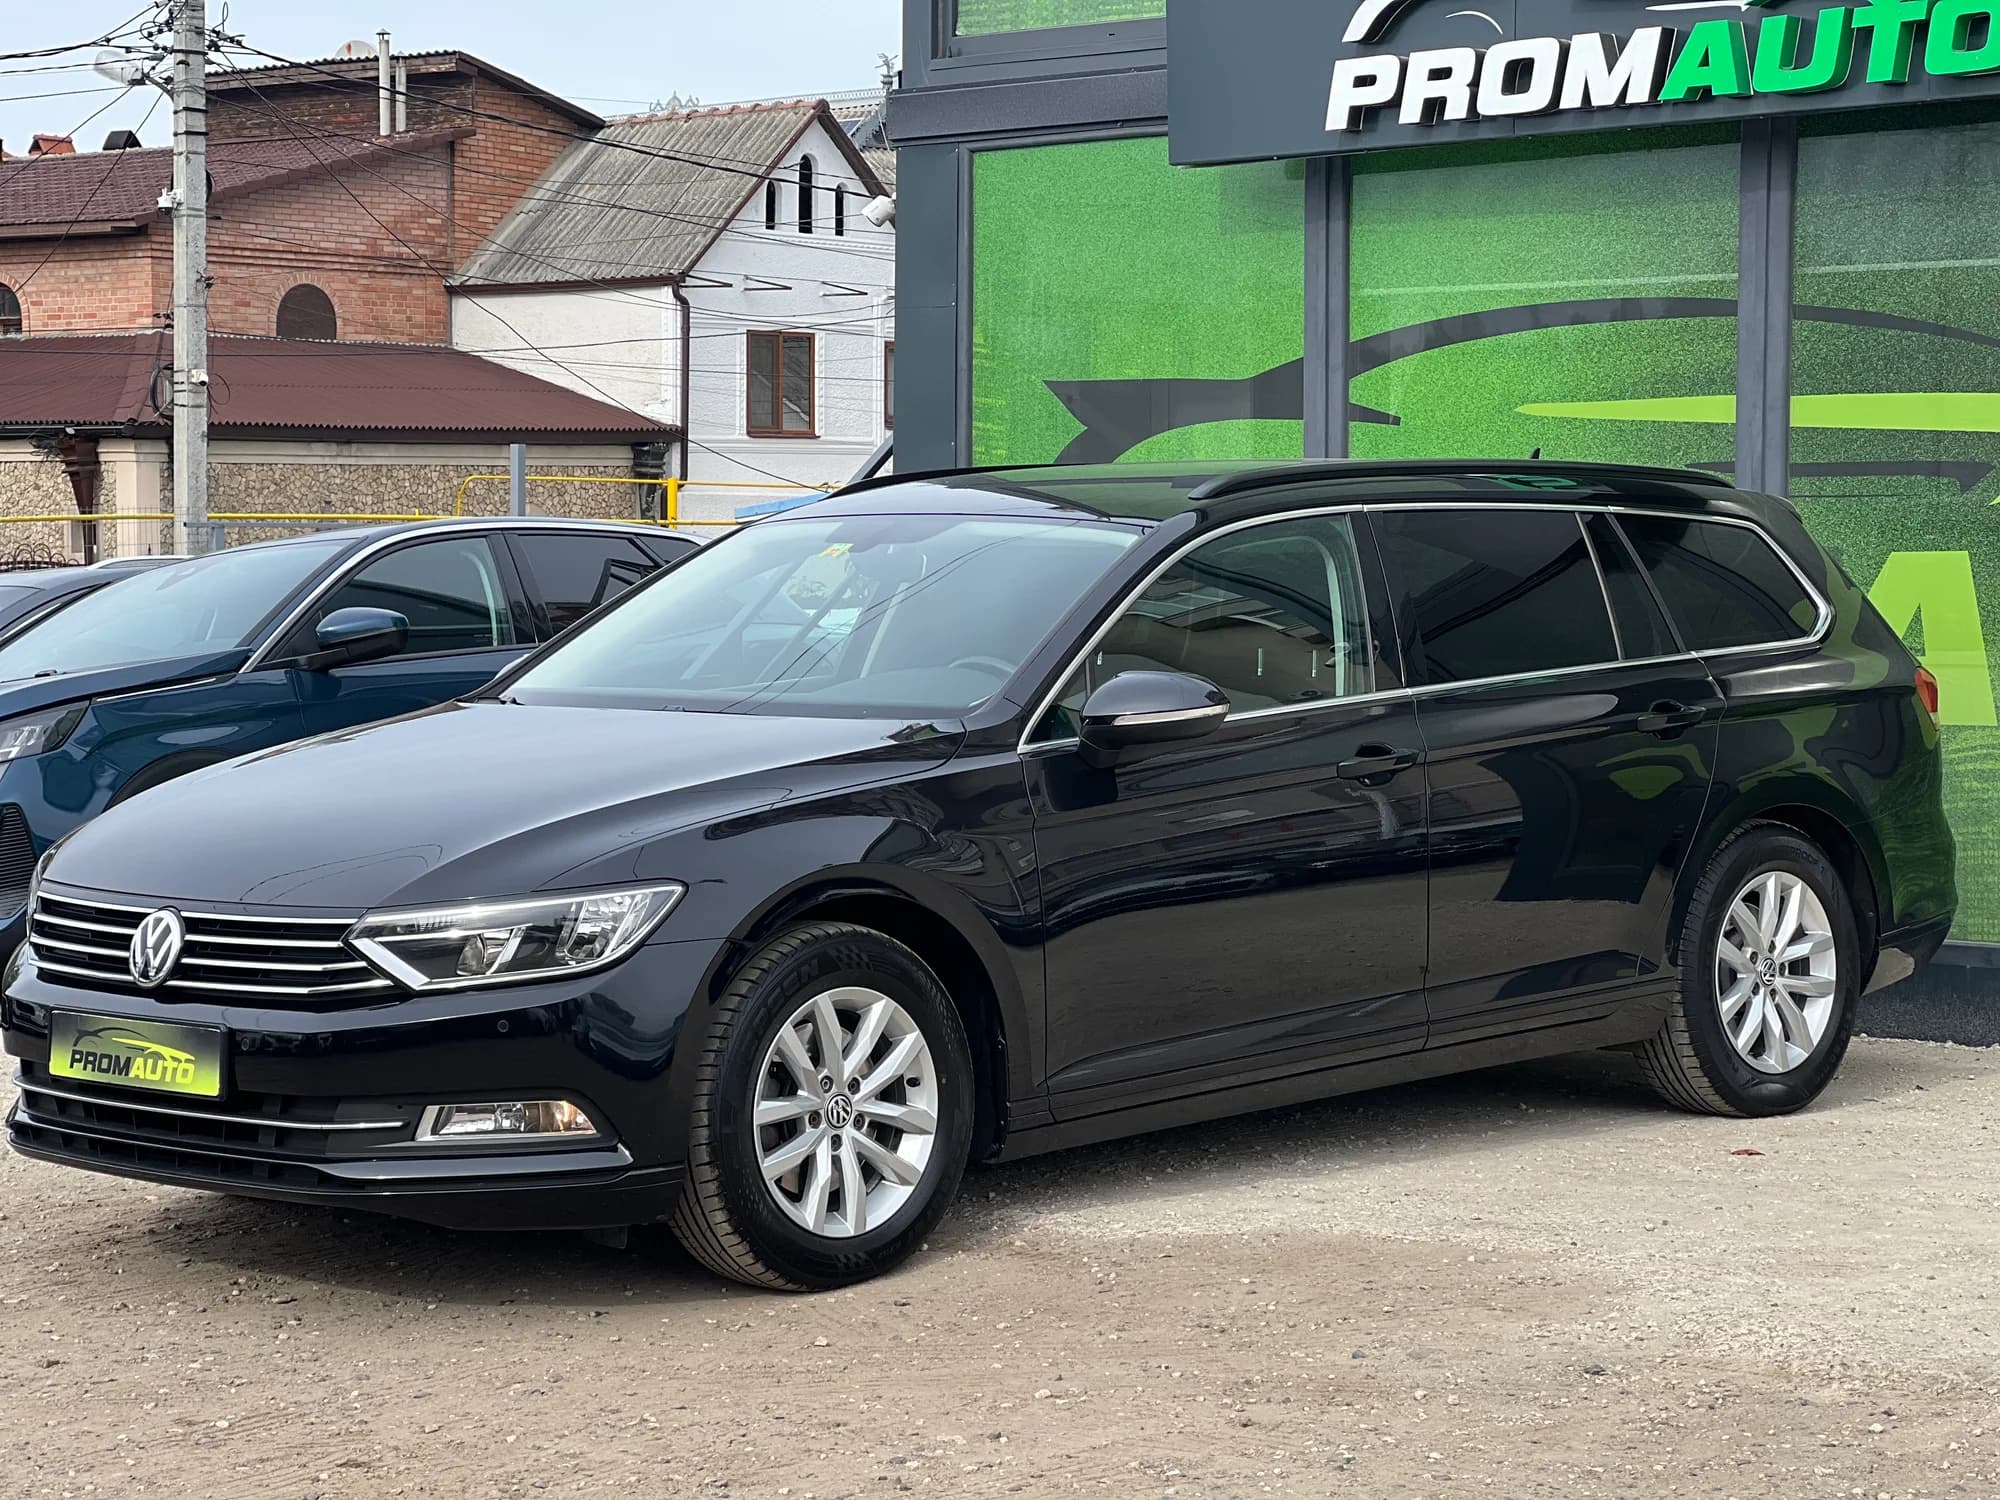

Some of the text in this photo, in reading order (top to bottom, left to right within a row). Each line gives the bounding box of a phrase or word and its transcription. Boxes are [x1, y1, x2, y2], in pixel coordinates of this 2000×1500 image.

[1324, 0, 2000, 131] PROMAUTO
[129, 907, 184, 988] VW
[69, 1048, 196, 1084] PROMAUTO
